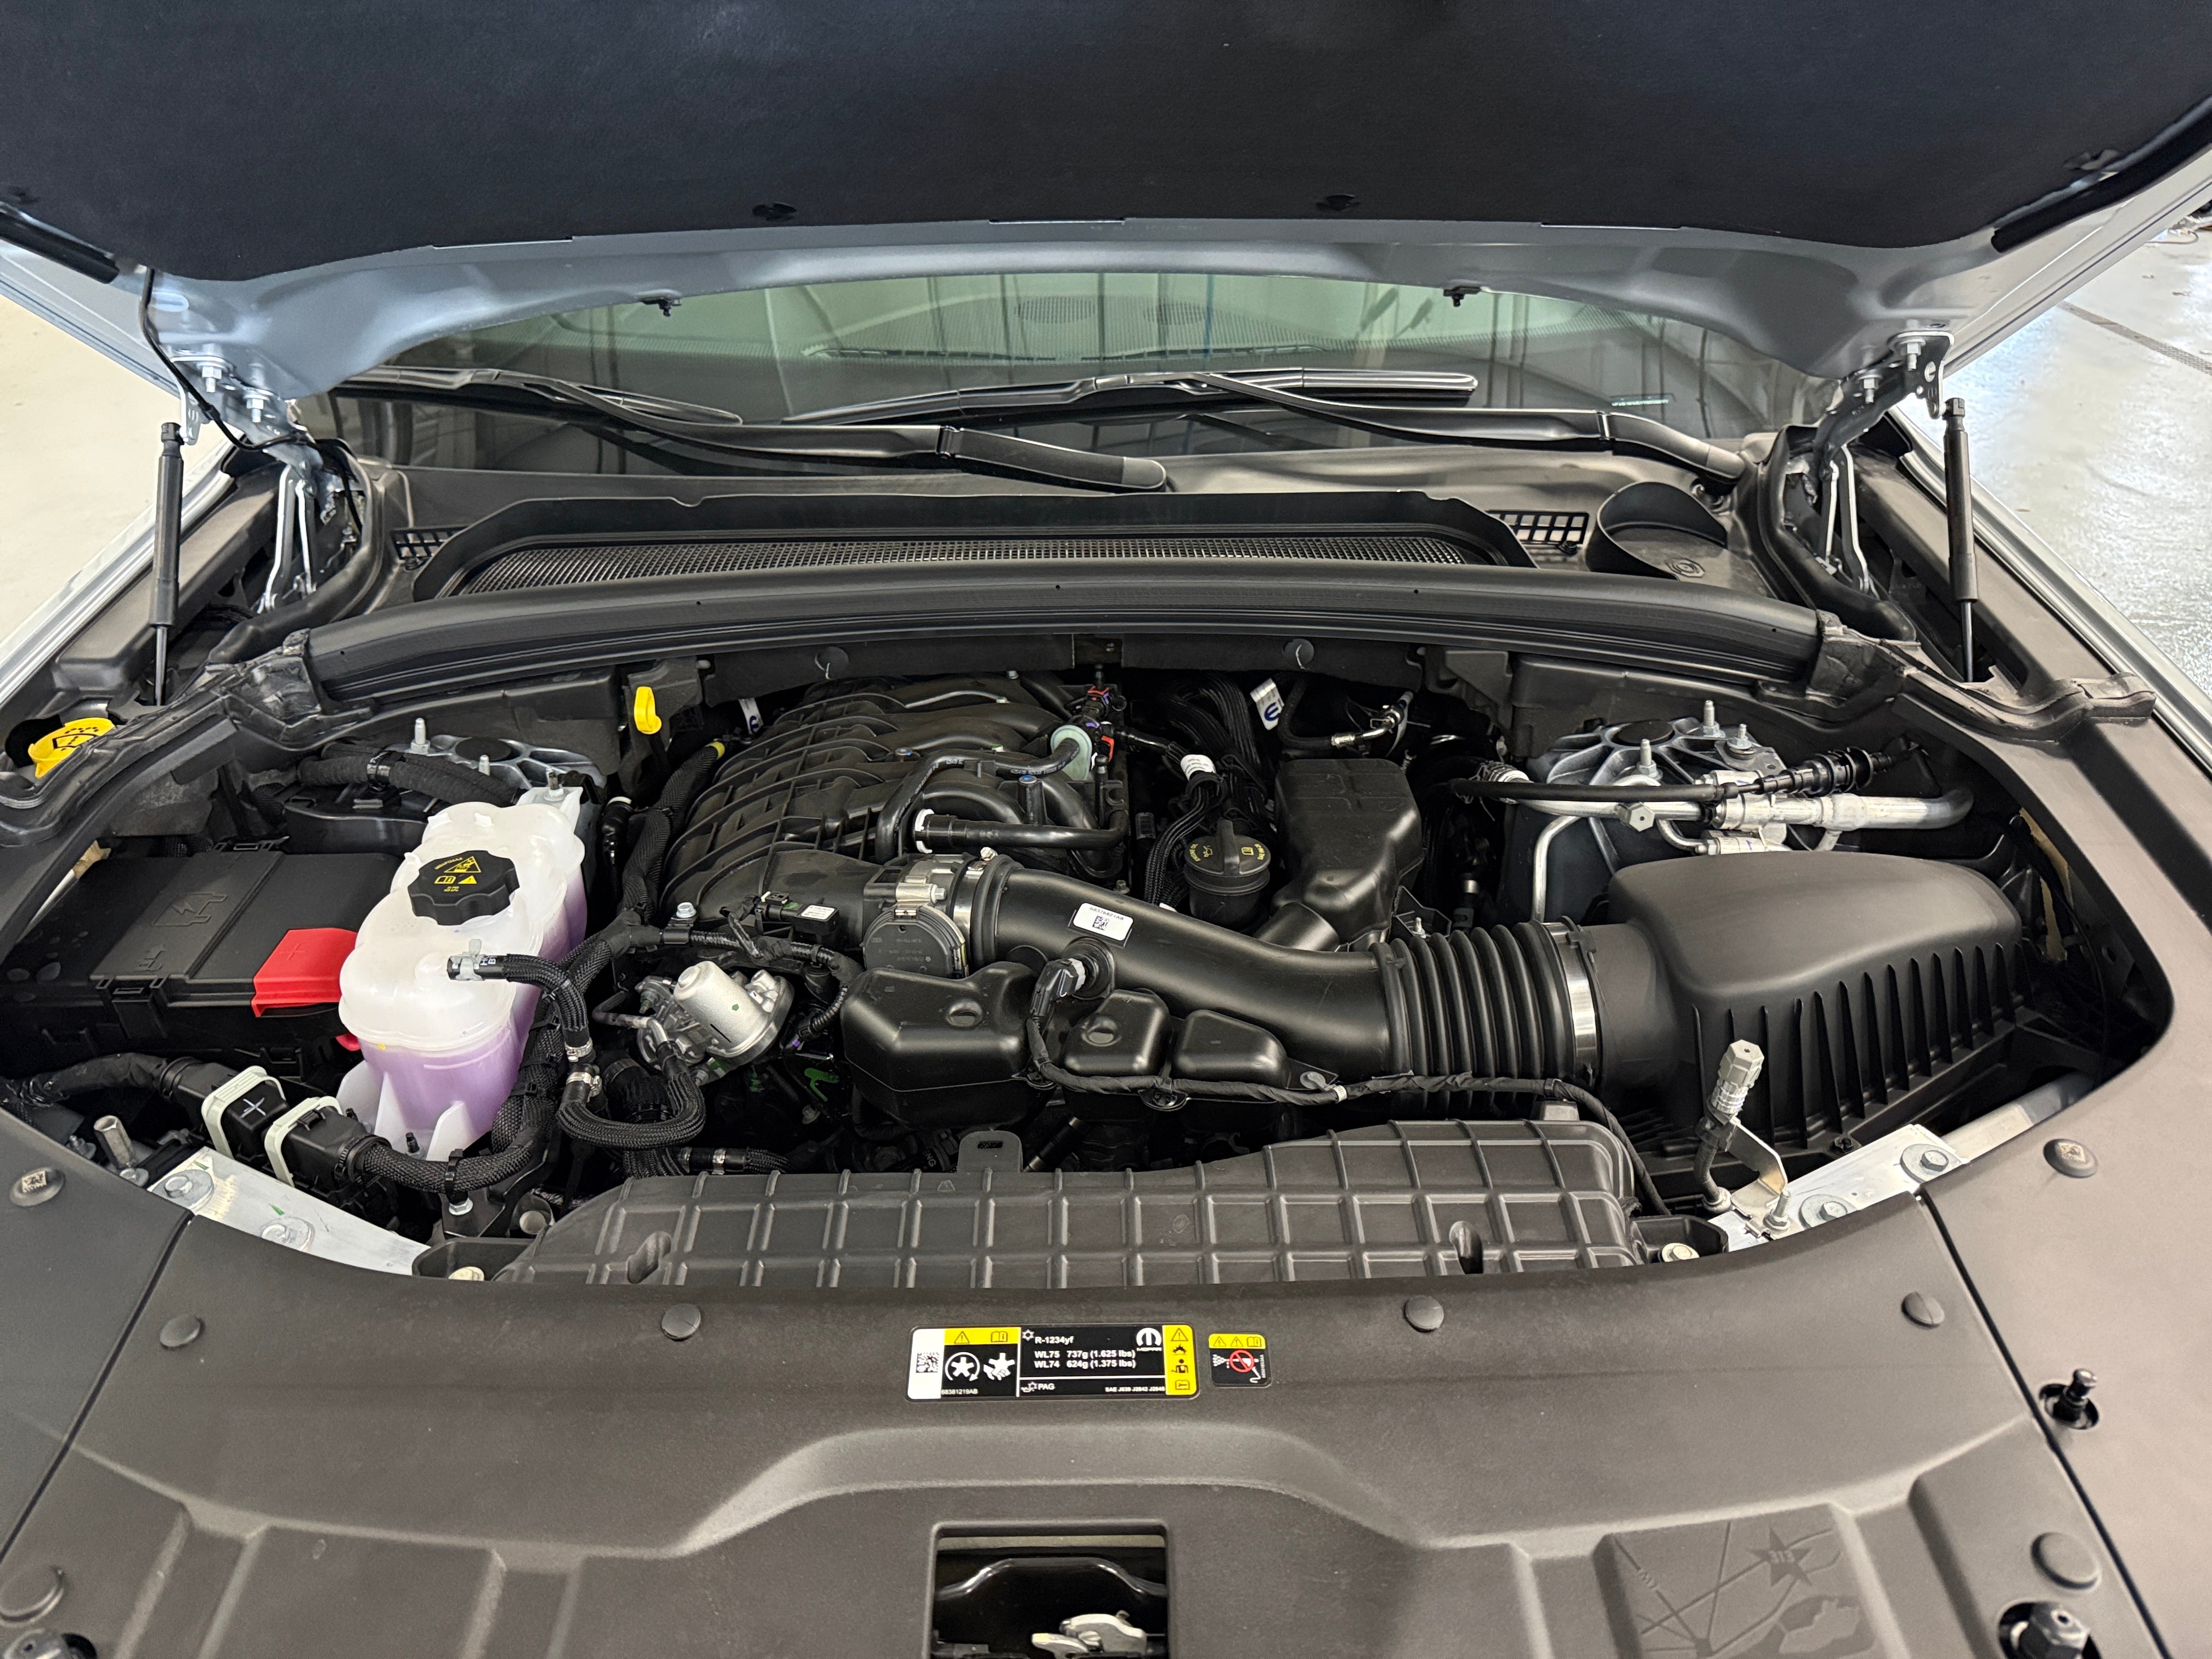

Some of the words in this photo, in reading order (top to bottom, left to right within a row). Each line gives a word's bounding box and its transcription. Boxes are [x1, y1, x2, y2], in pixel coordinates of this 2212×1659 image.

[1035, 1336, 1074, 1345] R-1234yf
[1034, 1350, 1060, 1358] WL75
[1066, 1350, 1088, 1359] 737g
[1090, 1350, 1117, 1359] (1.625
[1119, 1349, 1136, 1359] lbs)
[1034, 1360, 1060, 1368] WL74
[1066, 1360, 1088, 1369] 624g
[1090, 1359, 1118, 1369] (1.375
[1119, 1359, 1137, 1369] lbs)
